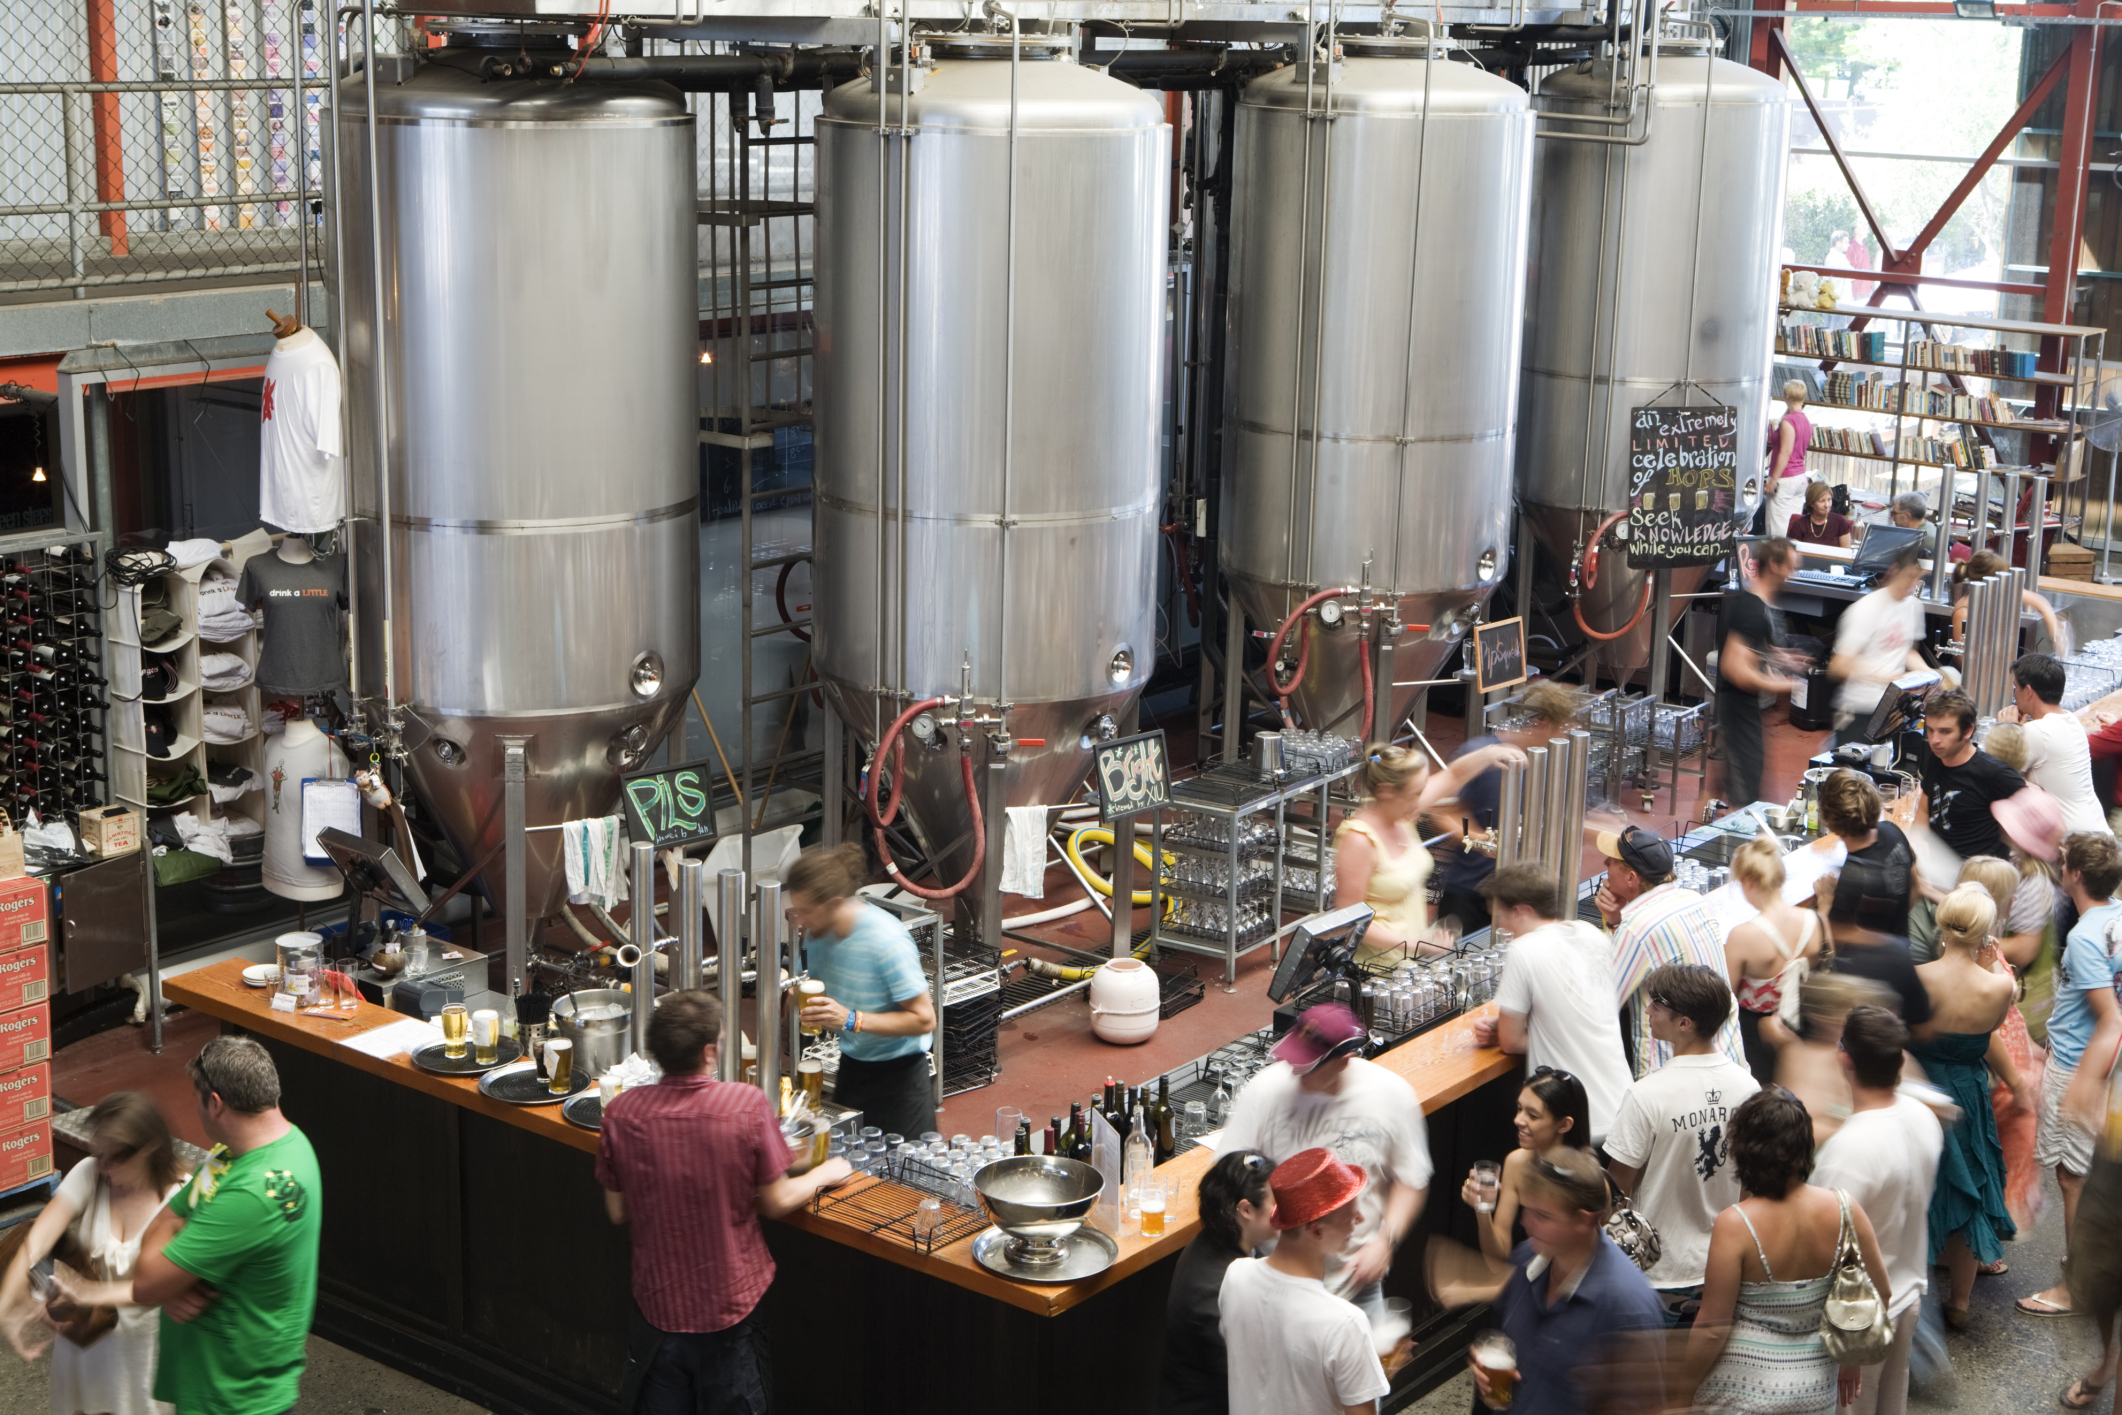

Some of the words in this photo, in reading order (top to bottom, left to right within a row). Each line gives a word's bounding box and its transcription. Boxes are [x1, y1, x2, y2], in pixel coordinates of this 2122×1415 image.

[1635, 411, 1662, 429] an
[1659, 407, 1737, 436] extremely
[1632, 435, 1730, 451] LIMITED
[1632, 445, 1737, 472] celebration
[1630, 469, 1655, 497] of
[1665, 467, 1735, 490] HOPS
[1630, 507, 1682, 529] Seek
[1634, 520, 1732, 544] KNOWLEDGE
[1666, 546, 1691, 558] you
[269, 588, 292, 597] drink
[302, 589, 329, 597] LITTLE
[1099, 738, 1163, 802] Bright
[114, 840, 129, 848] TEA
